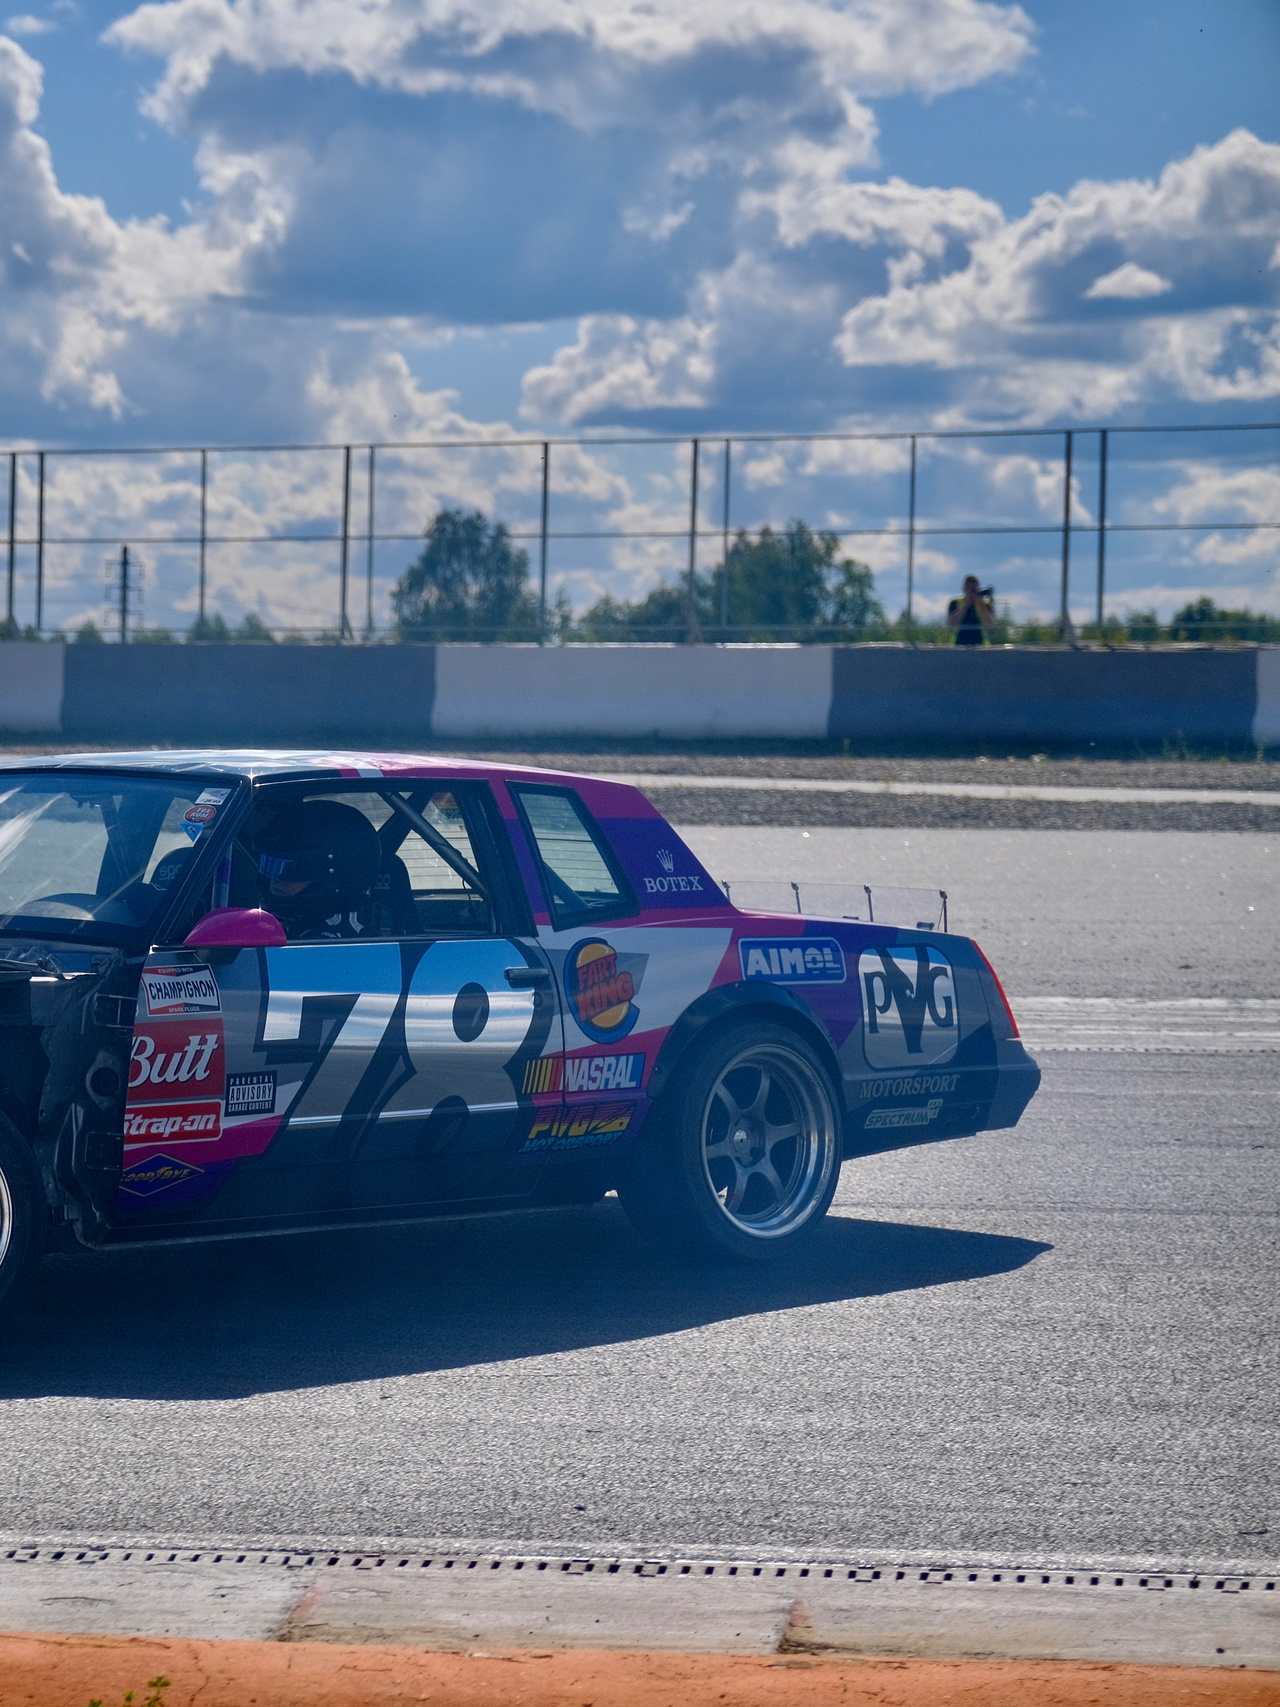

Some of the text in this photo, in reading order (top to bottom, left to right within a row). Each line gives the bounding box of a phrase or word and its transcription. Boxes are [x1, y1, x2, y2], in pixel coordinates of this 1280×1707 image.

[643, 876, 704, 894] BOTEX
[578, 954, 617, 991] FART
[747, 946, 842, 976] AIMOL
[148, 979, 216, 1000] CHAMPIGNON
[577, 972, 635, 1021] KING
[129, 1034, 218, 1088] Butt
[260, 939, 540, 1165] 78
[229, 1075, 274, 1086] PARENTAL
[559, 1055, 636, 1092] NASRAL
[230, 1084, 273, 1102] ADVISORY
[859, 1074, 960, 1099] MOTORSPORT
[228, 1101, 272, 1112] GARAGE CONTENT
[866, 1110, 929, 1127] SPECTRUM
[518, 1131, 623, 1153] MOTORSPORT
